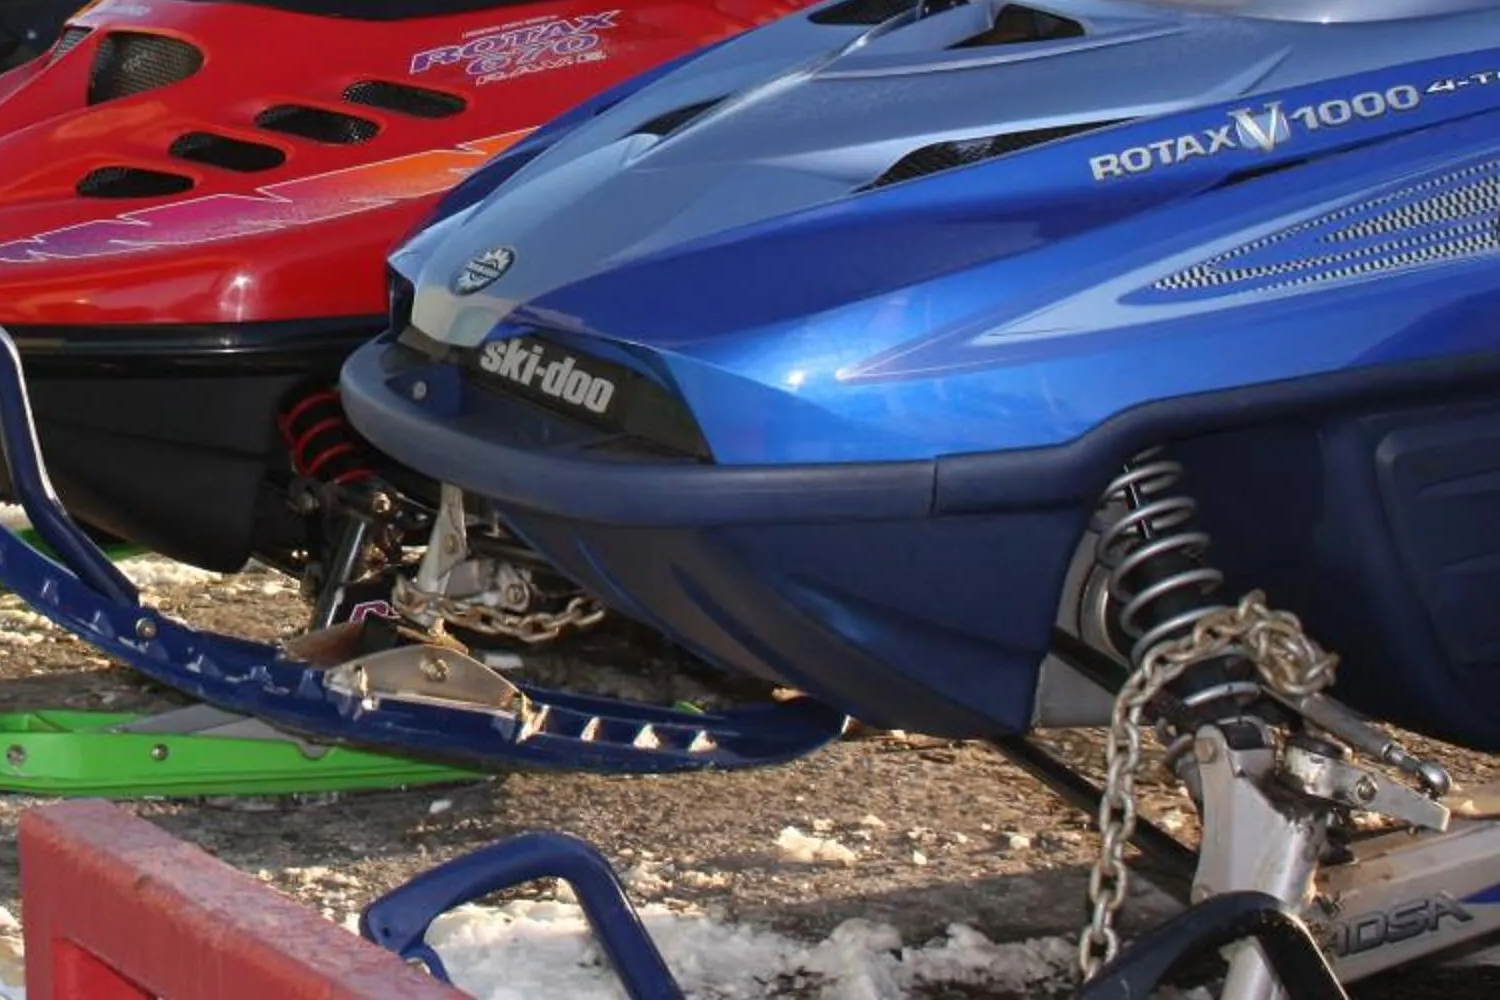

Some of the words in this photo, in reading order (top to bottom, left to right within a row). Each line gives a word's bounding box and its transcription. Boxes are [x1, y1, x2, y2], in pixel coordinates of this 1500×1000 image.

[409, 9, 621, 75] ROTAX
[1089, 125, 1236, 181] ROTAX
[1289, 85, 1420, 131] 1000
[1425, 71, 1500, 94] 4-T
[480, 337, 615, 414] ski-doo
